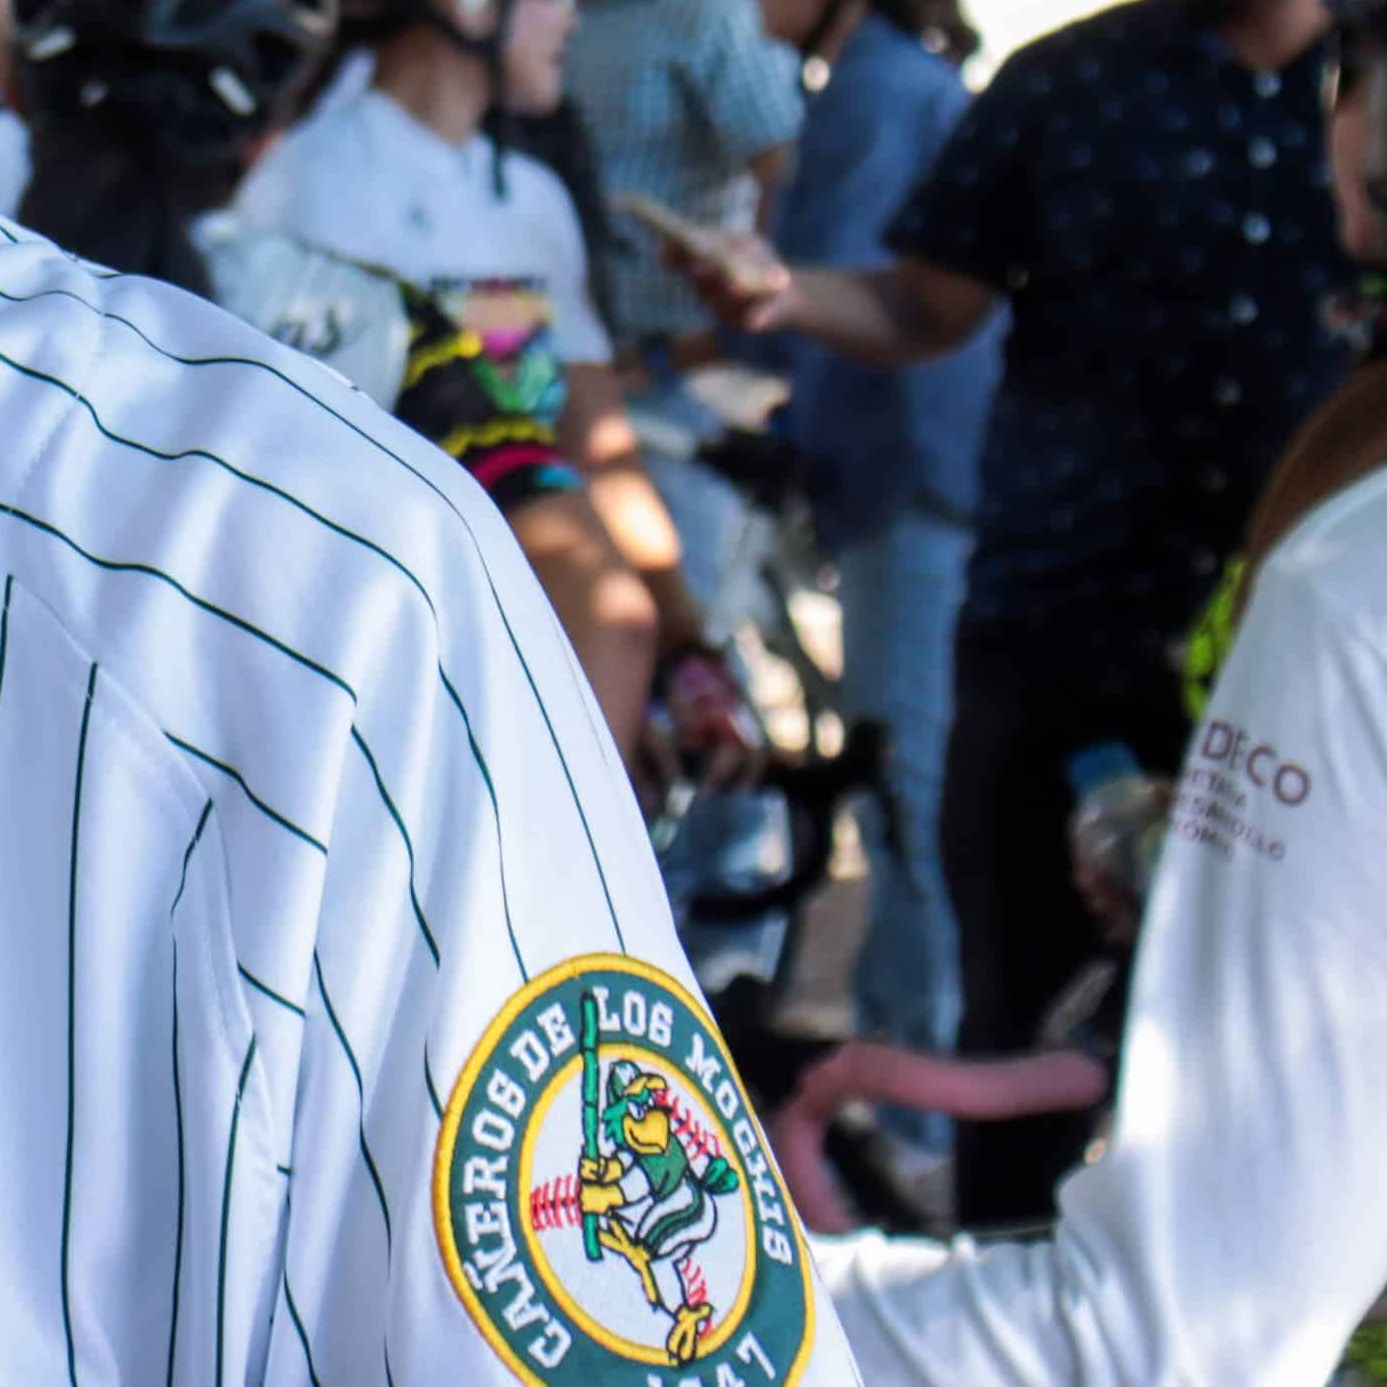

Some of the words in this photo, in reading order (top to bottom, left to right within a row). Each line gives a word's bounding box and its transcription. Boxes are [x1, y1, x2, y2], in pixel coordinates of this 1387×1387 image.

[509, 1001, 577, 1083] DE
[591, 986, 674, 1049] LOS
[462, 1068, 573, 1369] CAÑEROS
[684, 1033, 794, 1266] MOCHIS
